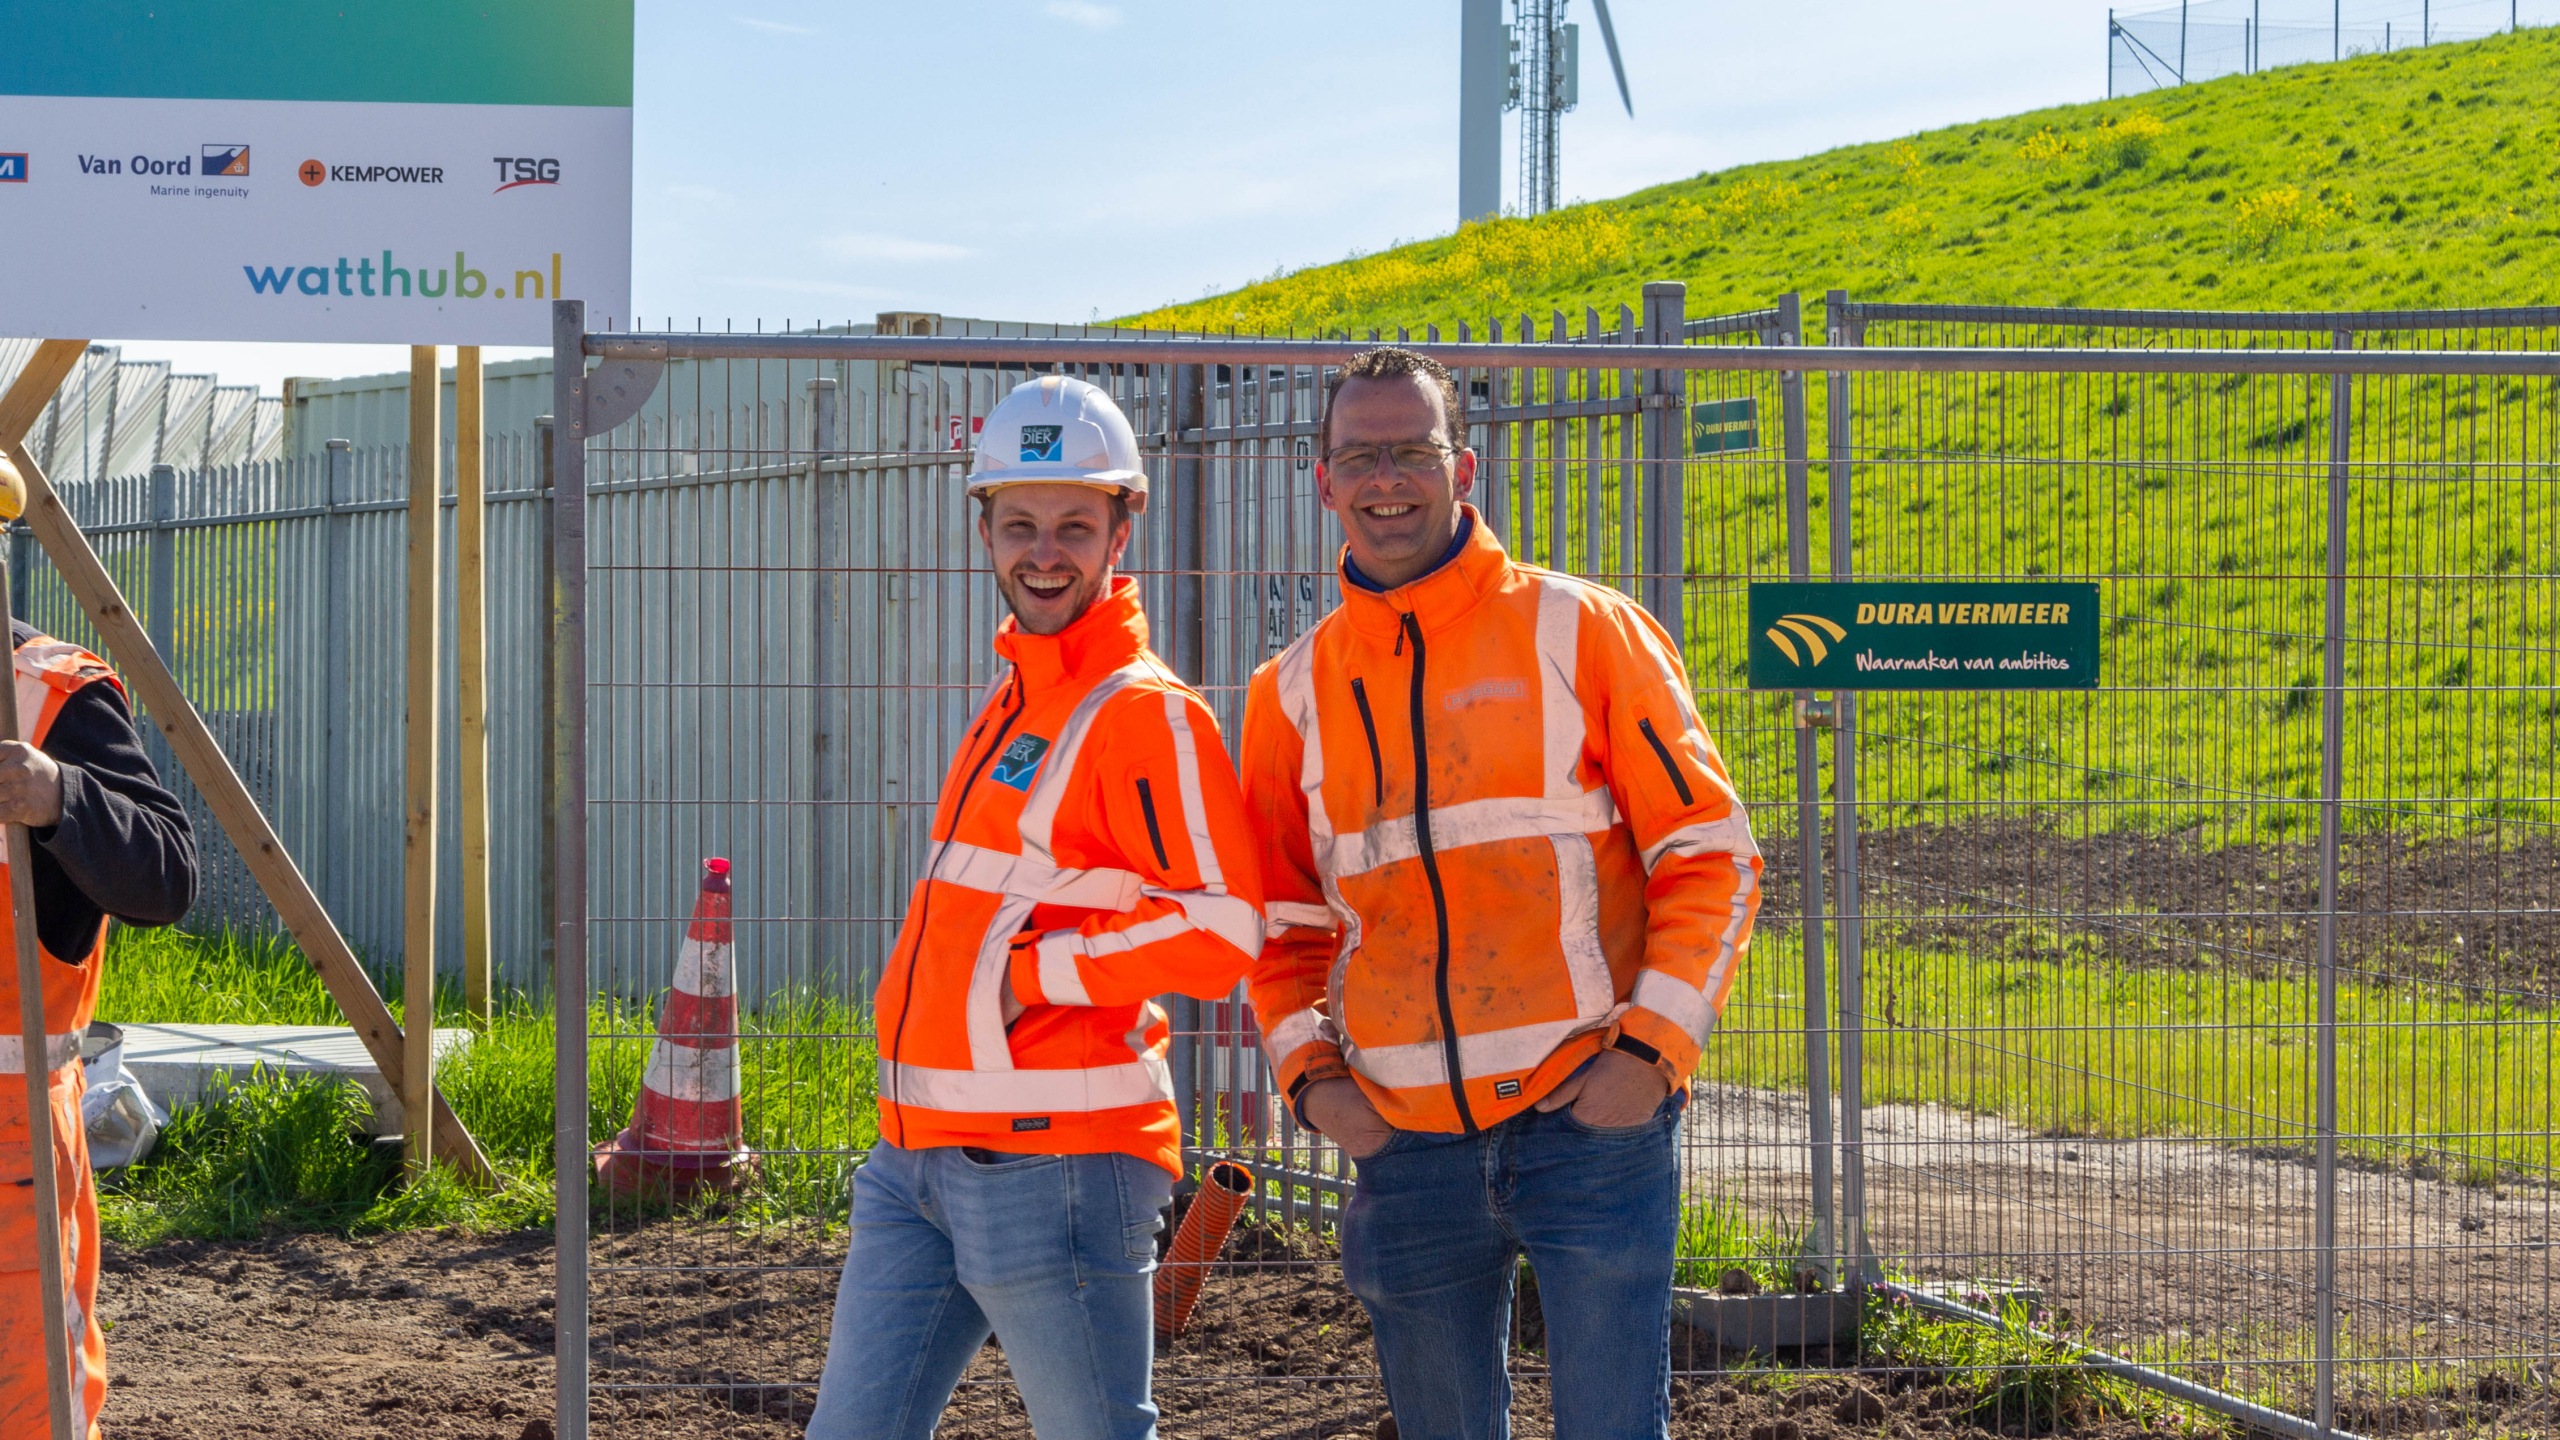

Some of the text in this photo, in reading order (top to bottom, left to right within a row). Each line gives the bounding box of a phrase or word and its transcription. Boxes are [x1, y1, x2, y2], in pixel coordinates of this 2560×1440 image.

[78, 154, 191, 176] Van Oord
[331, 165, 444, 184] KEMPOWER
[493, 157, 560, 184] TSG
[150, 185, 249, 199] Marine ingenuity
[243, 250, 562, 300] watthub.nl
[1021, 432, 1052, 445] DIEK
[1856, 603, 2071, 625] DURA VERMEER
[1856, 648, 2070, 672] Waarmaken van ambities
[1451, 685, 1517, 706] PLOEGAM
[1003, 741, 1036, 762] DIEK
